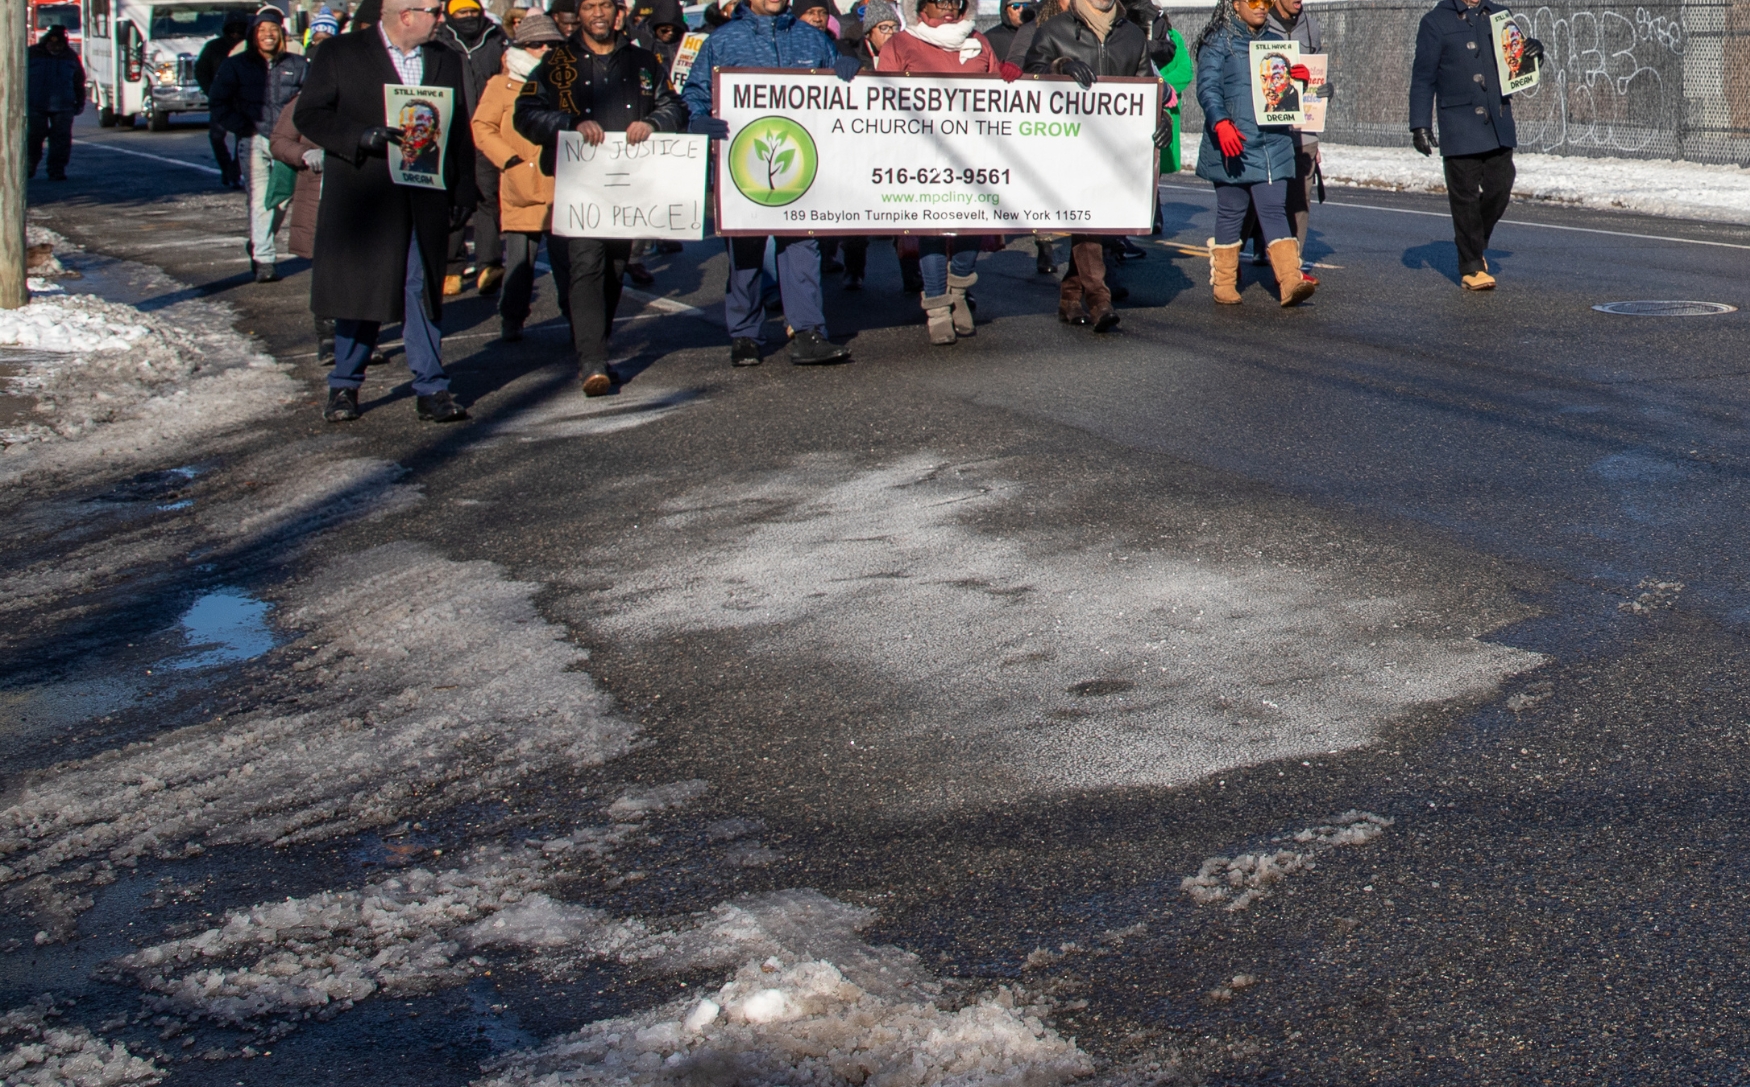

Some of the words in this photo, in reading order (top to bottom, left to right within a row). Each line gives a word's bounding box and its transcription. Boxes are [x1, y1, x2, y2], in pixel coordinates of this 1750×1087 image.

[1510, 75, 1533, 90] DREAM
[394, 88, 415, 96] STILL
[417, 89, 437, 97] HAVE
[733, 84, 858, 110] MEMORIAL
[867, 86, 1041, 114] PRESBYTERIAN
[1050, 90, 1144, 116] CHURCH
[1266, 114, 1295, 122] DREAM
[831, 118, 845, 134] A
[851, 118, 934, 135] CHURCH
[941, 119, 968, 135] ON
[975, 120, 1012, 136] THE
[1019, 121, 1081, 137] GROW
[565, 139, 597, 162] NO
[609, 138, 699, 160] JUSTICE
[402, 173, 435, 185] DREAM
[871, 167, 1010, 185] 516-623-9561
[881, 190, 1000, 205] www.mpcliny.org
[569, 202, 600, 231] NO
[612, 200, 701, 231] PEACE!
[783, 210, 806, 221] 189
[810, 210, 860, 223] Babylon
[865, 209, 918, 222] Turnpike
[923, 209, 989, 222] Roosevelt,
[993, 210, 1019, 221] New
[1024, 210, 1050, 221] York
[1055, 210, 1091, 221] 11575
